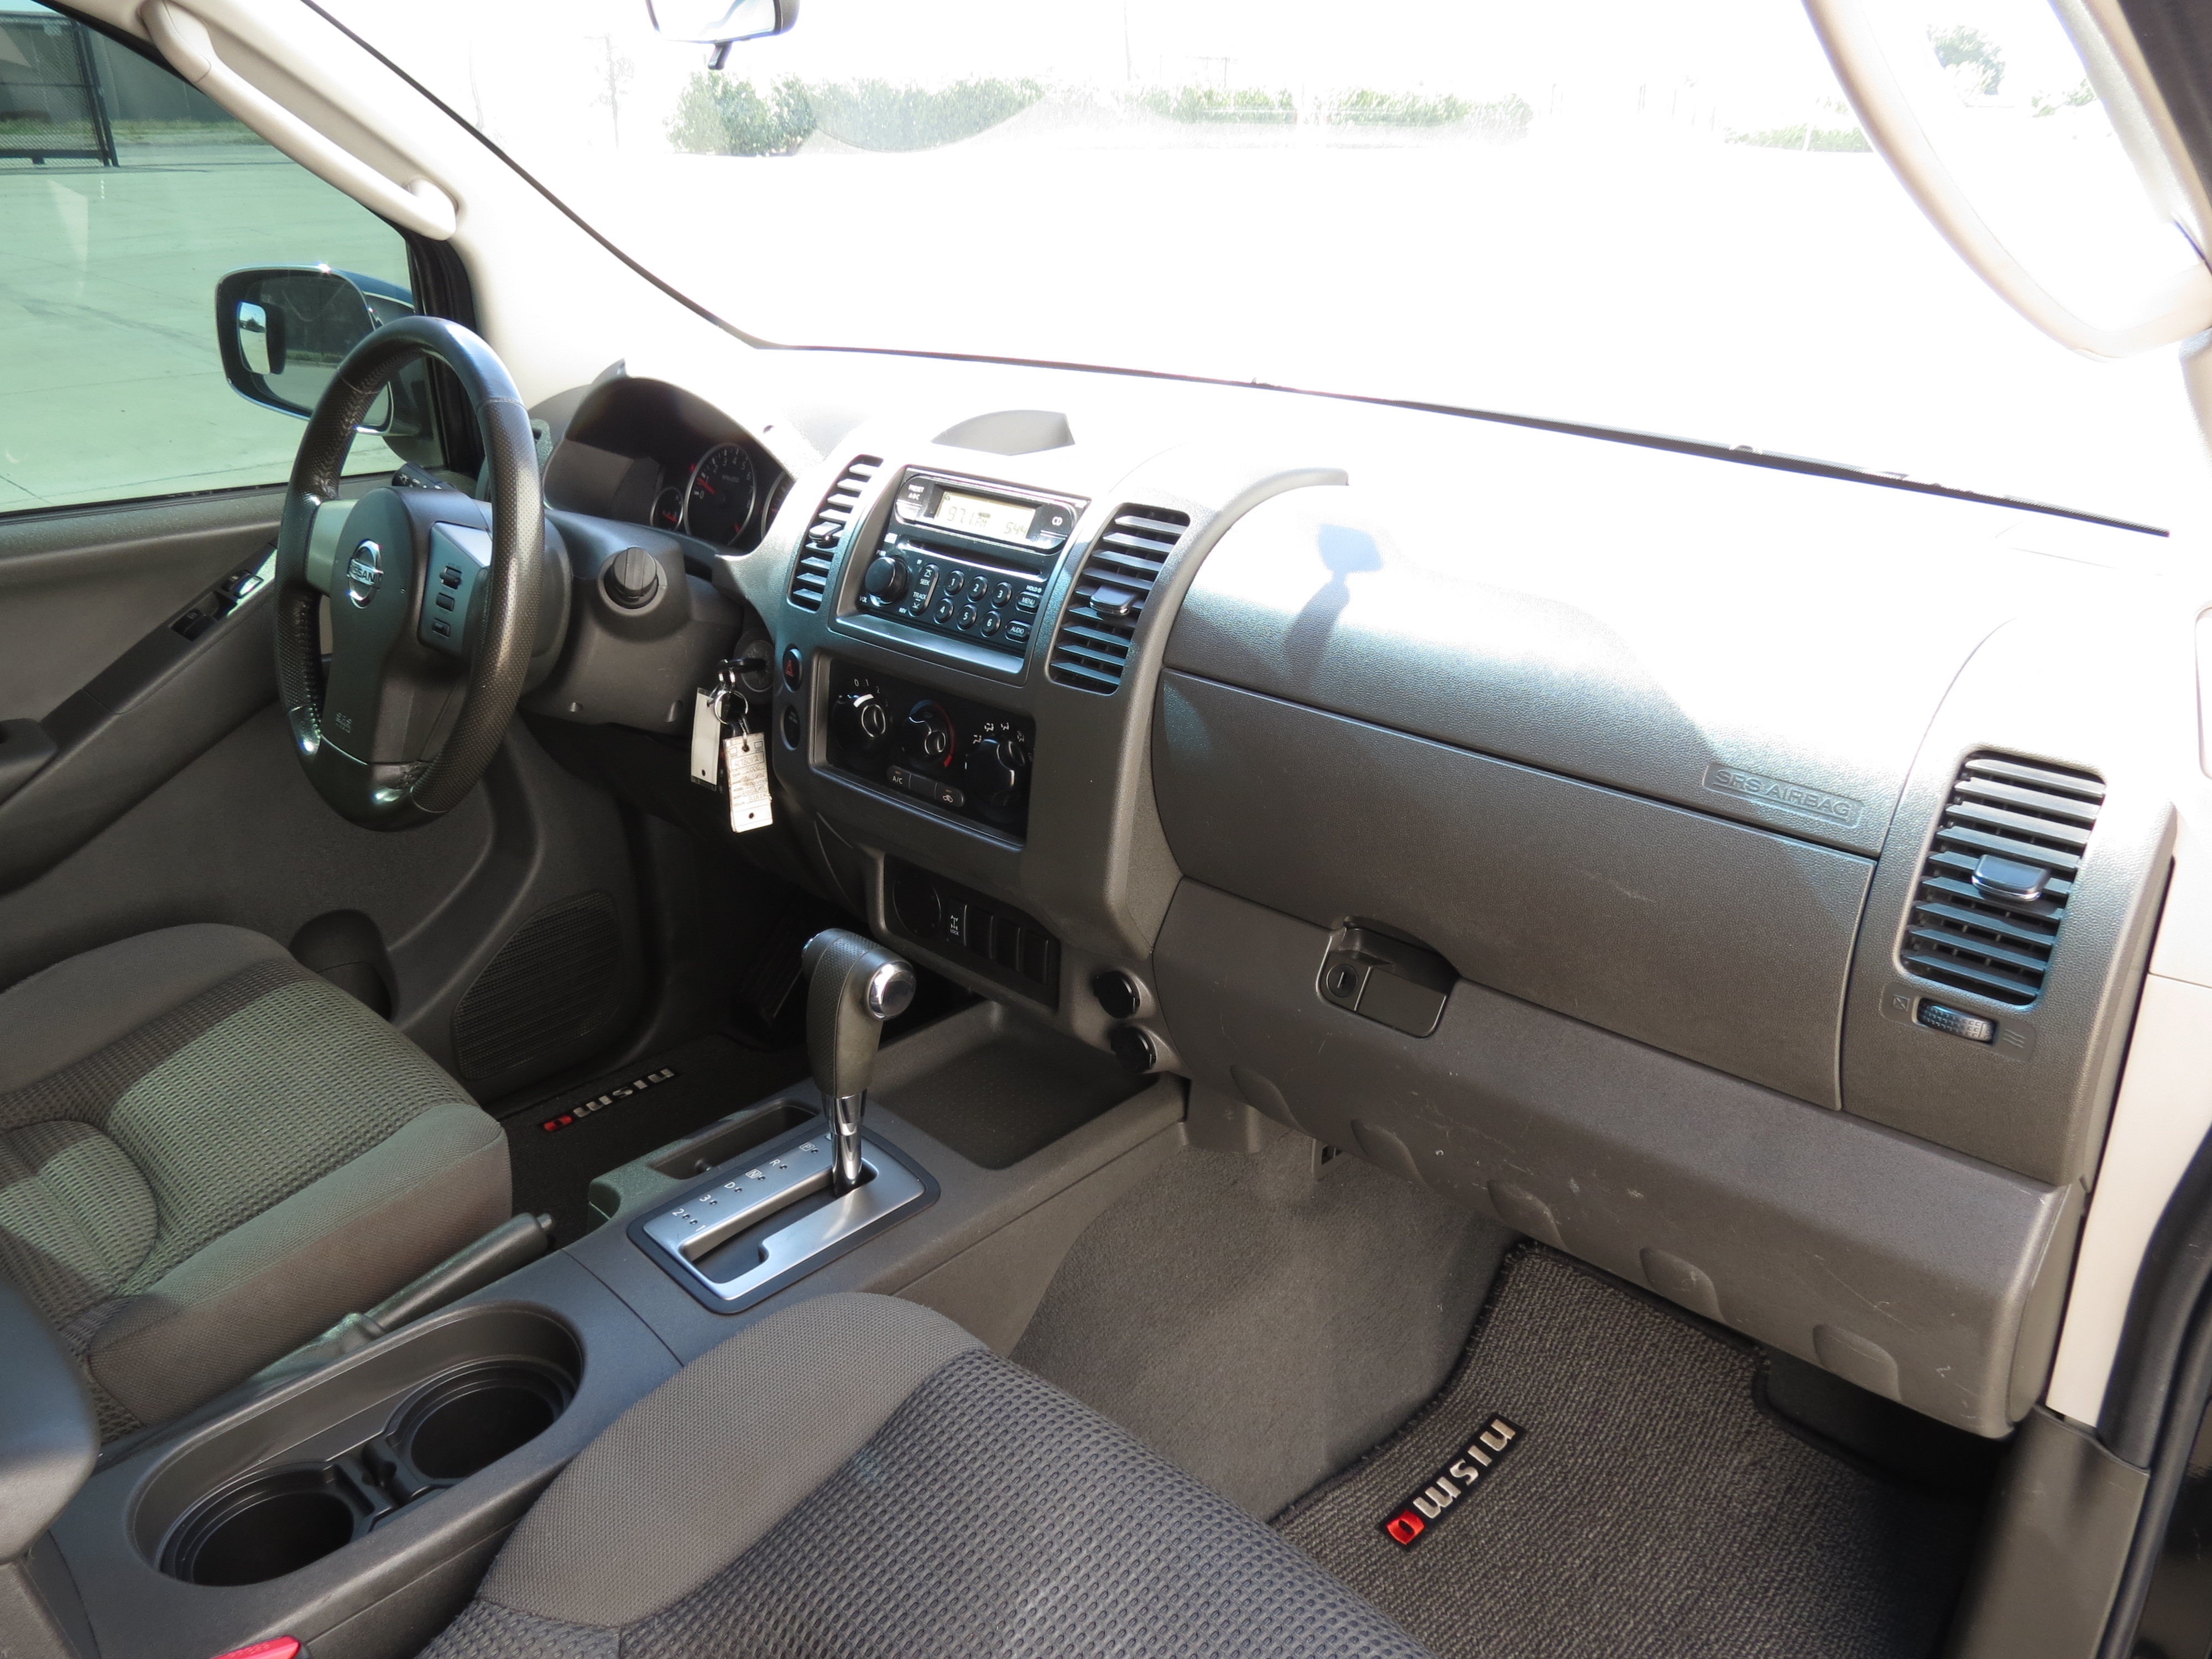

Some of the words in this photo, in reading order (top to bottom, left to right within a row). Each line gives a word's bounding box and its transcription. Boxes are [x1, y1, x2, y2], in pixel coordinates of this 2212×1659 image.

[1052, 516, 1063, 526] CD
[973, 584, 979, 592] 2
[913, 591, 927, 600] TRACK
[997, 590, 1003, 598] 3
[1021, 597, 1035, 606] MENU
[963, 612, 969, 620] 5
[1010, 626, 1025, 634] AUDIO
[892, 775, 903, 785] A/C
[1714, 769, 1762, 792] SRS
[1761, 784, 1851, 820] AIRBAG
[699, 1194, 712, 1202] 3
[672, 1208, 685, 1217] 2
[1385, 1418, 1516, 1545] nismo
